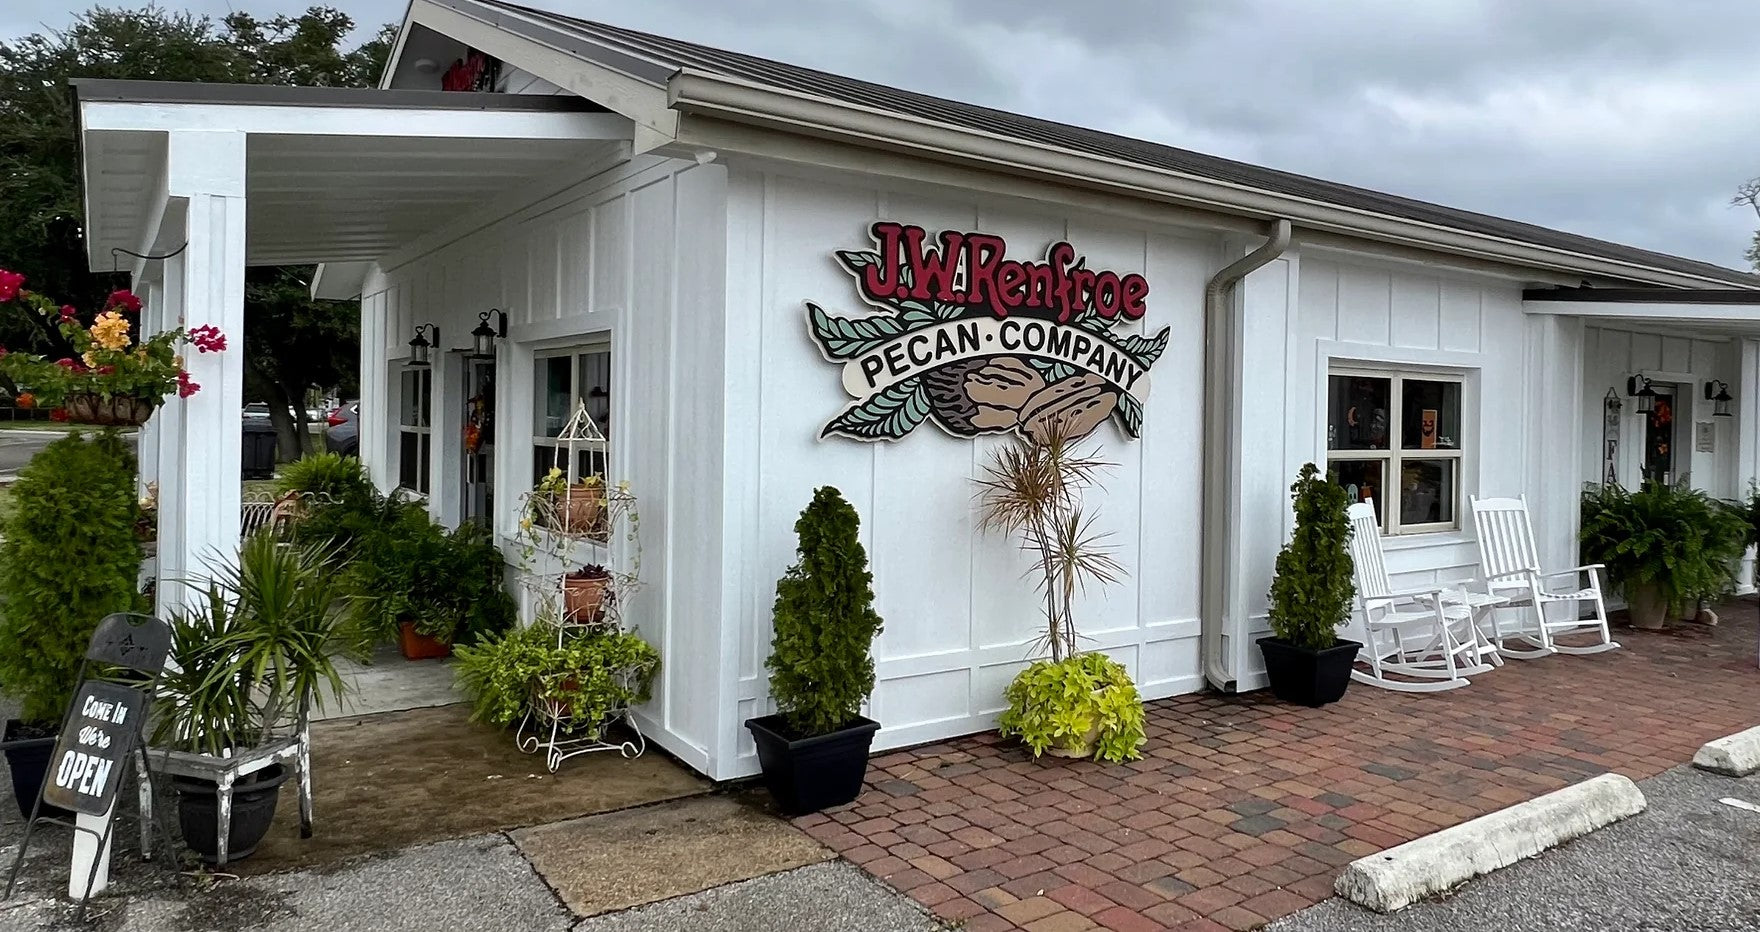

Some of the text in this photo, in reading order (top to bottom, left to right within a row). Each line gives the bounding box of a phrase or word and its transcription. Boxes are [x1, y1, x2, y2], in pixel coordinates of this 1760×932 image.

[860, 321, 1143, 391] PECAN COMPANY
[56, 750, 114, 798] OPEN
